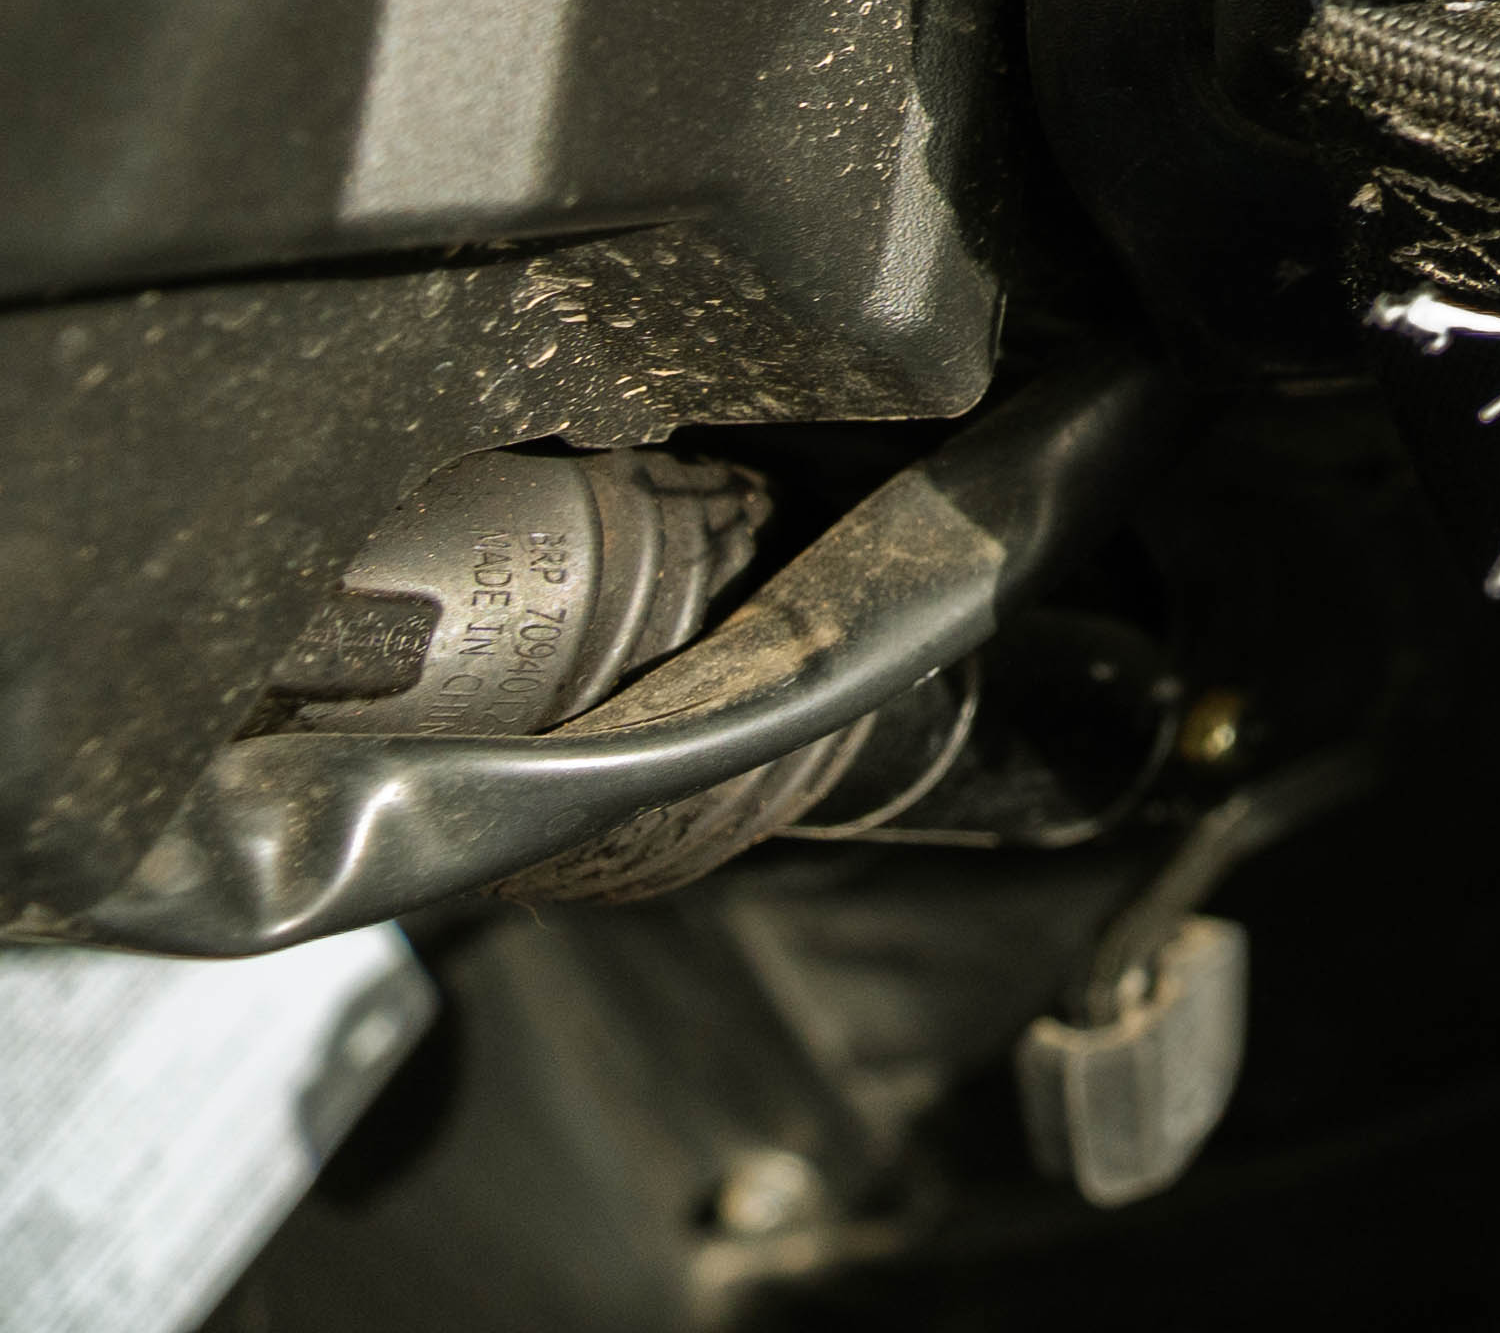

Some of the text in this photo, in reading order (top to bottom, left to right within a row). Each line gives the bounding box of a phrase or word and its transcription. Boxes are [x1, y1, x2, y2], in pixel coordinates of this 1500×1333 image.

[528, 531, 567, 584] BRP
[417, 531, 513, 733] MADE IN CHIN
